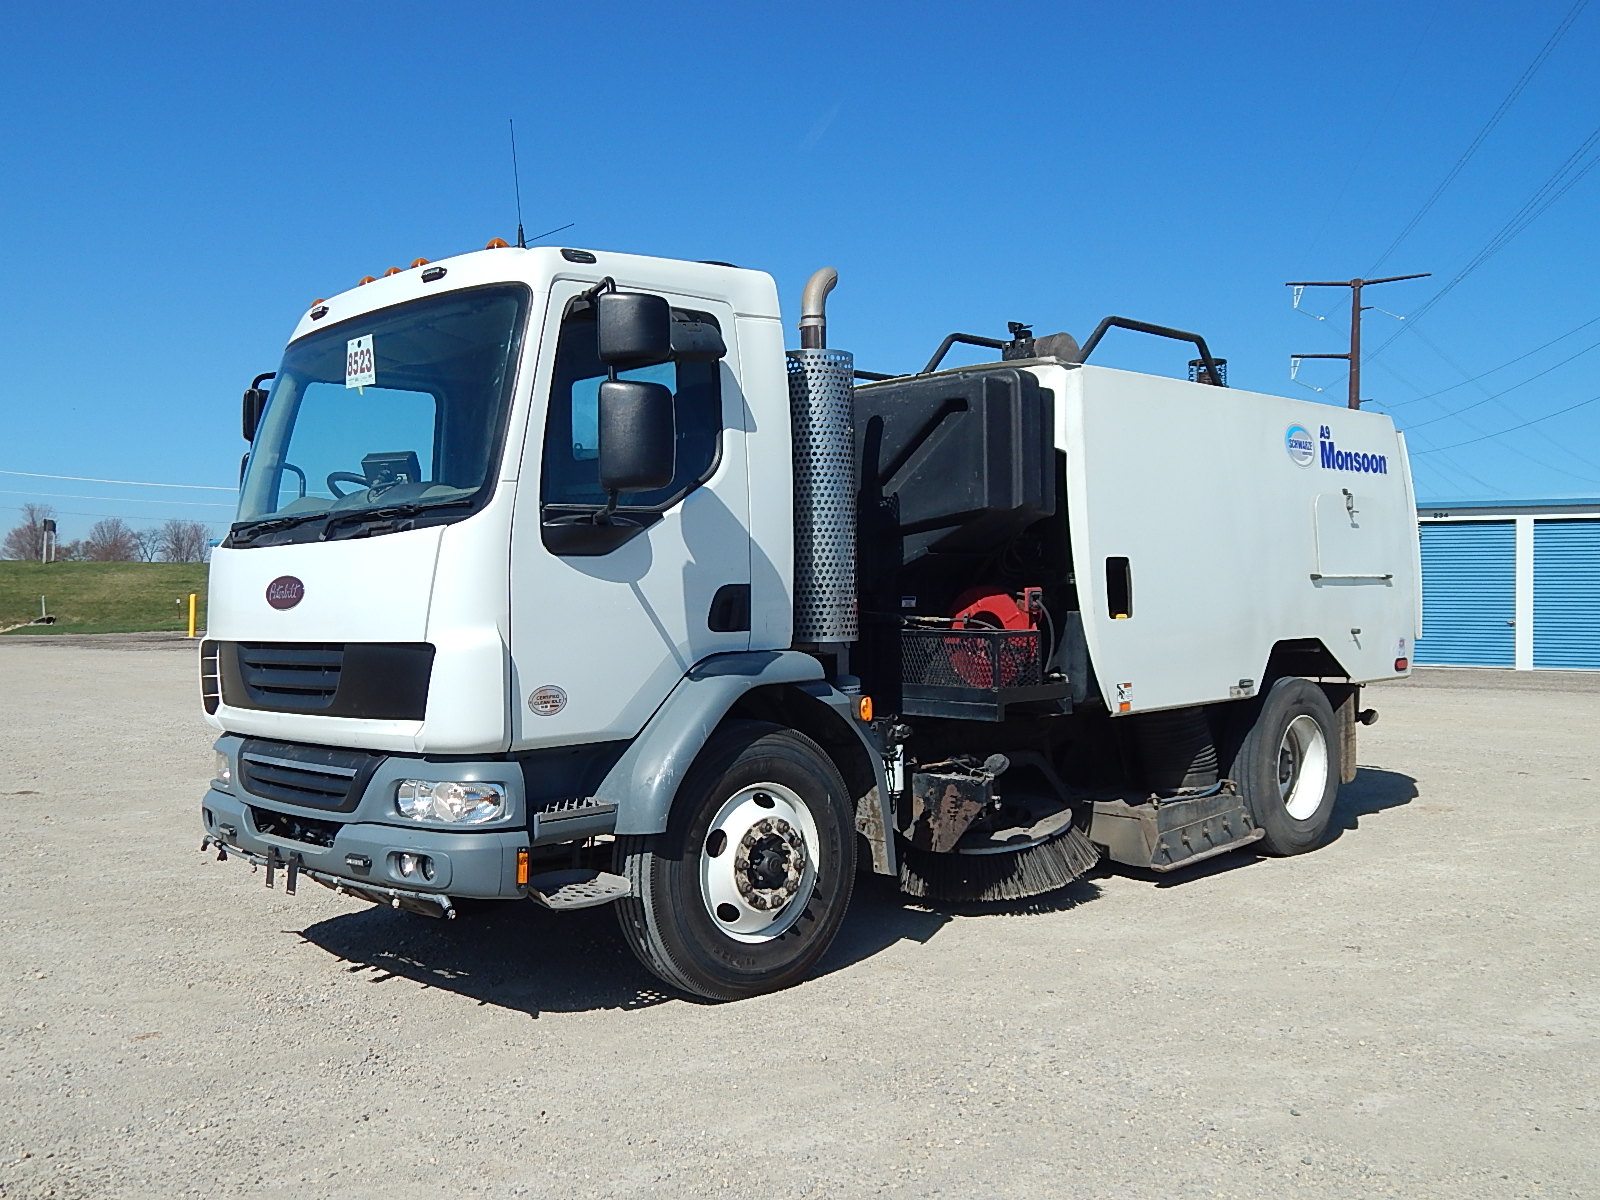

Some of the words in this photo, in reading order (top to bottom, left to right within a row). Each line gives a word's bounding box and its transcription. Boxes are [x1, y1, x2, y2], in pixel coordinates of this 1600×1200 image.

[347, 348, 372, 377] 8523
[1319, 424, 1331, 440] A9
[1289, 439, 1313, 451] SCHWARZE
[1320, 440, 1388, 475] Monsoon
